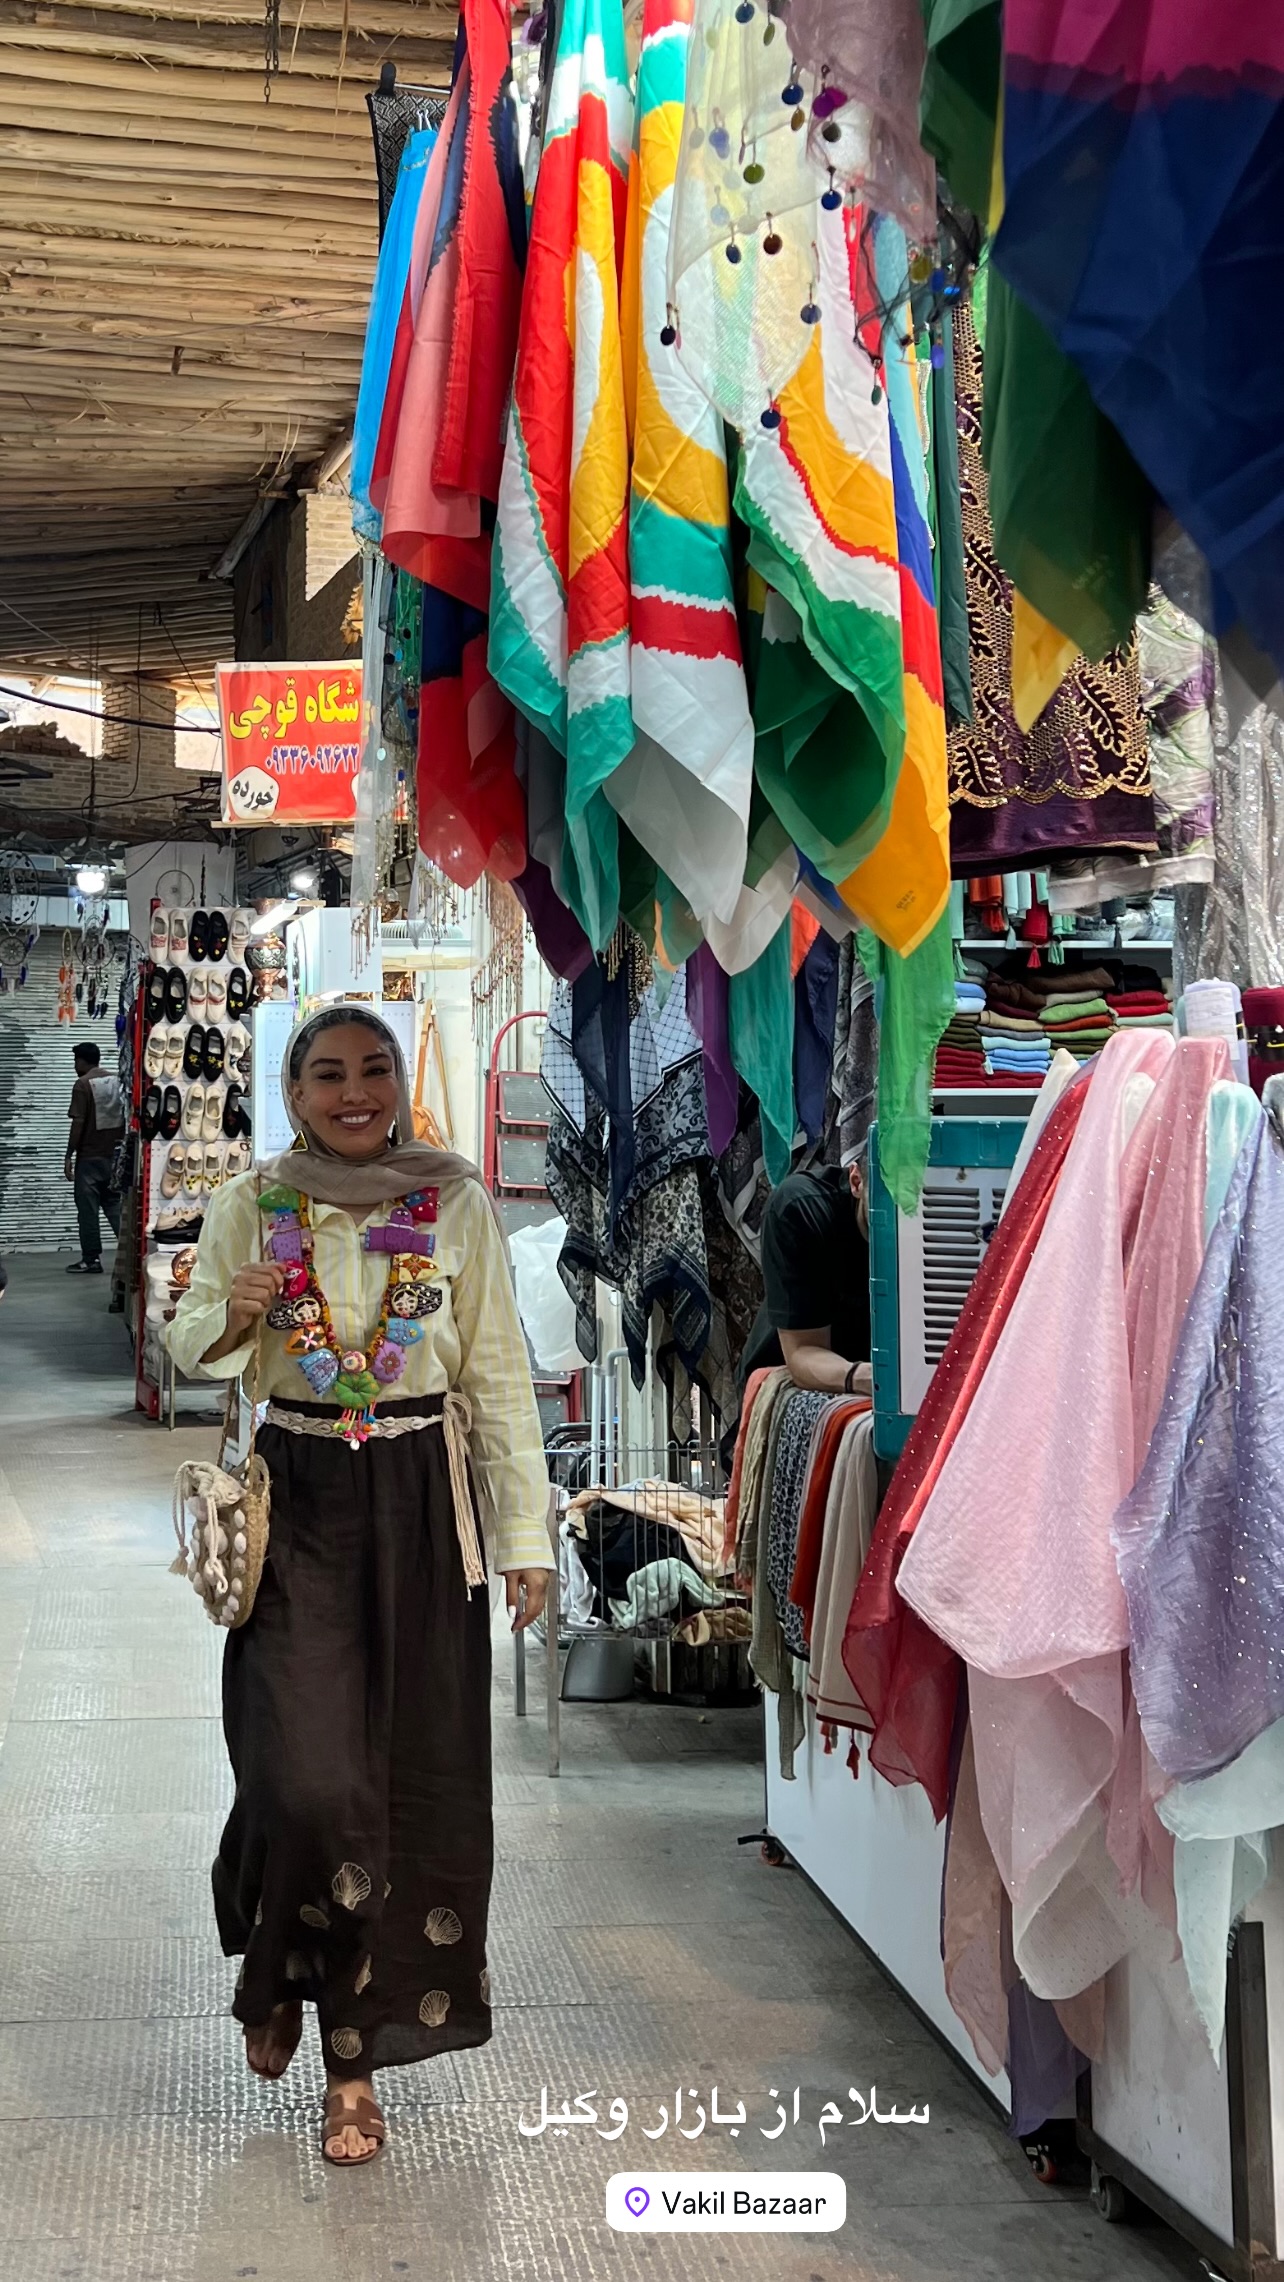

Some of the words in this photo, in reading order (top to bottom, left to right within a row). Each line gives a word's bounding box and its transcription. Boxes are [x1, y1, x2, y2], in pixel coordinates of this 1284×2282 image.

[229, 677, 298, 740] قوچی
[305, 679, 359, 723] شگاه
[232, 780, 274, 810] خورده
